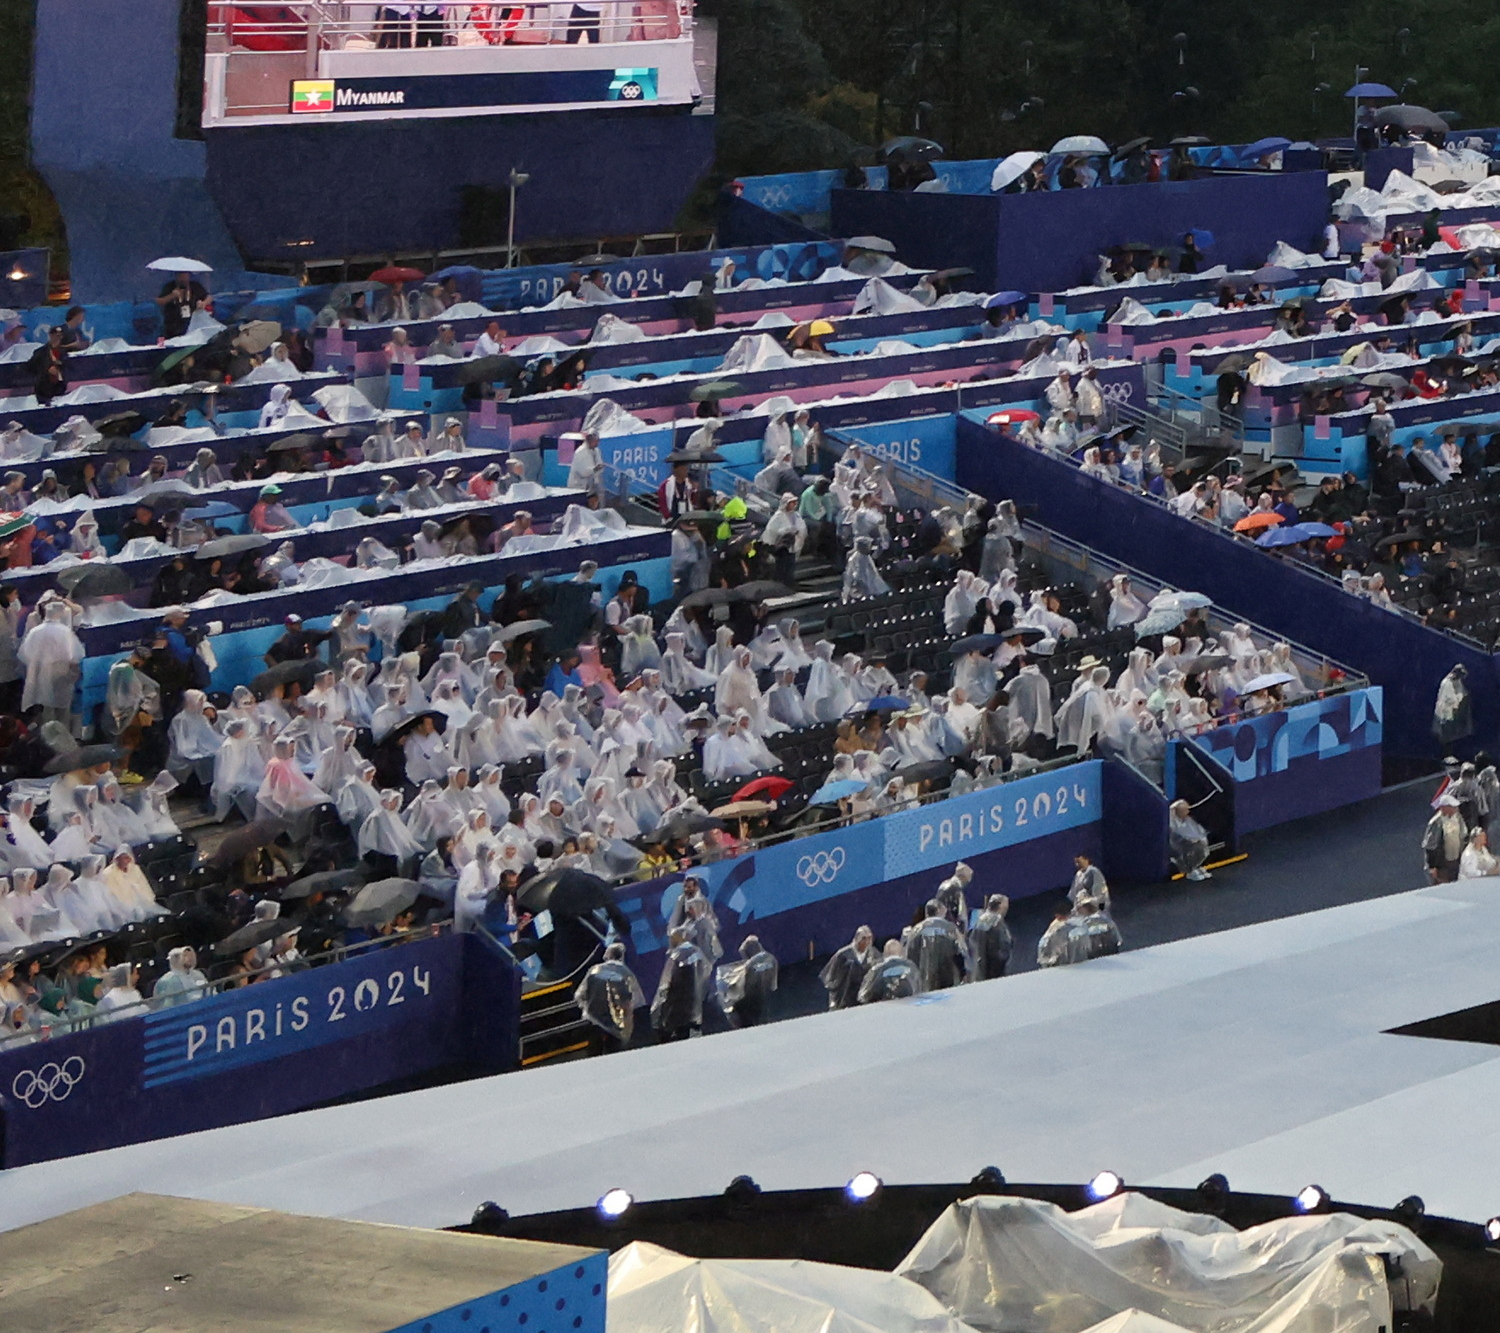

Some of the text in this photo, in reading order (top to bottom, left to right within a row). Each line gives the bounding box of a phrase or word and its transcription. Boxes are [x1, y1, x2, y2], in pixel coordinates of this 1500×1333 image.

[336, 88, 405, 106] MYANMAR
[1015, 783, 1087, 827] 2024
[327, 965, 431, 1023] 2024
